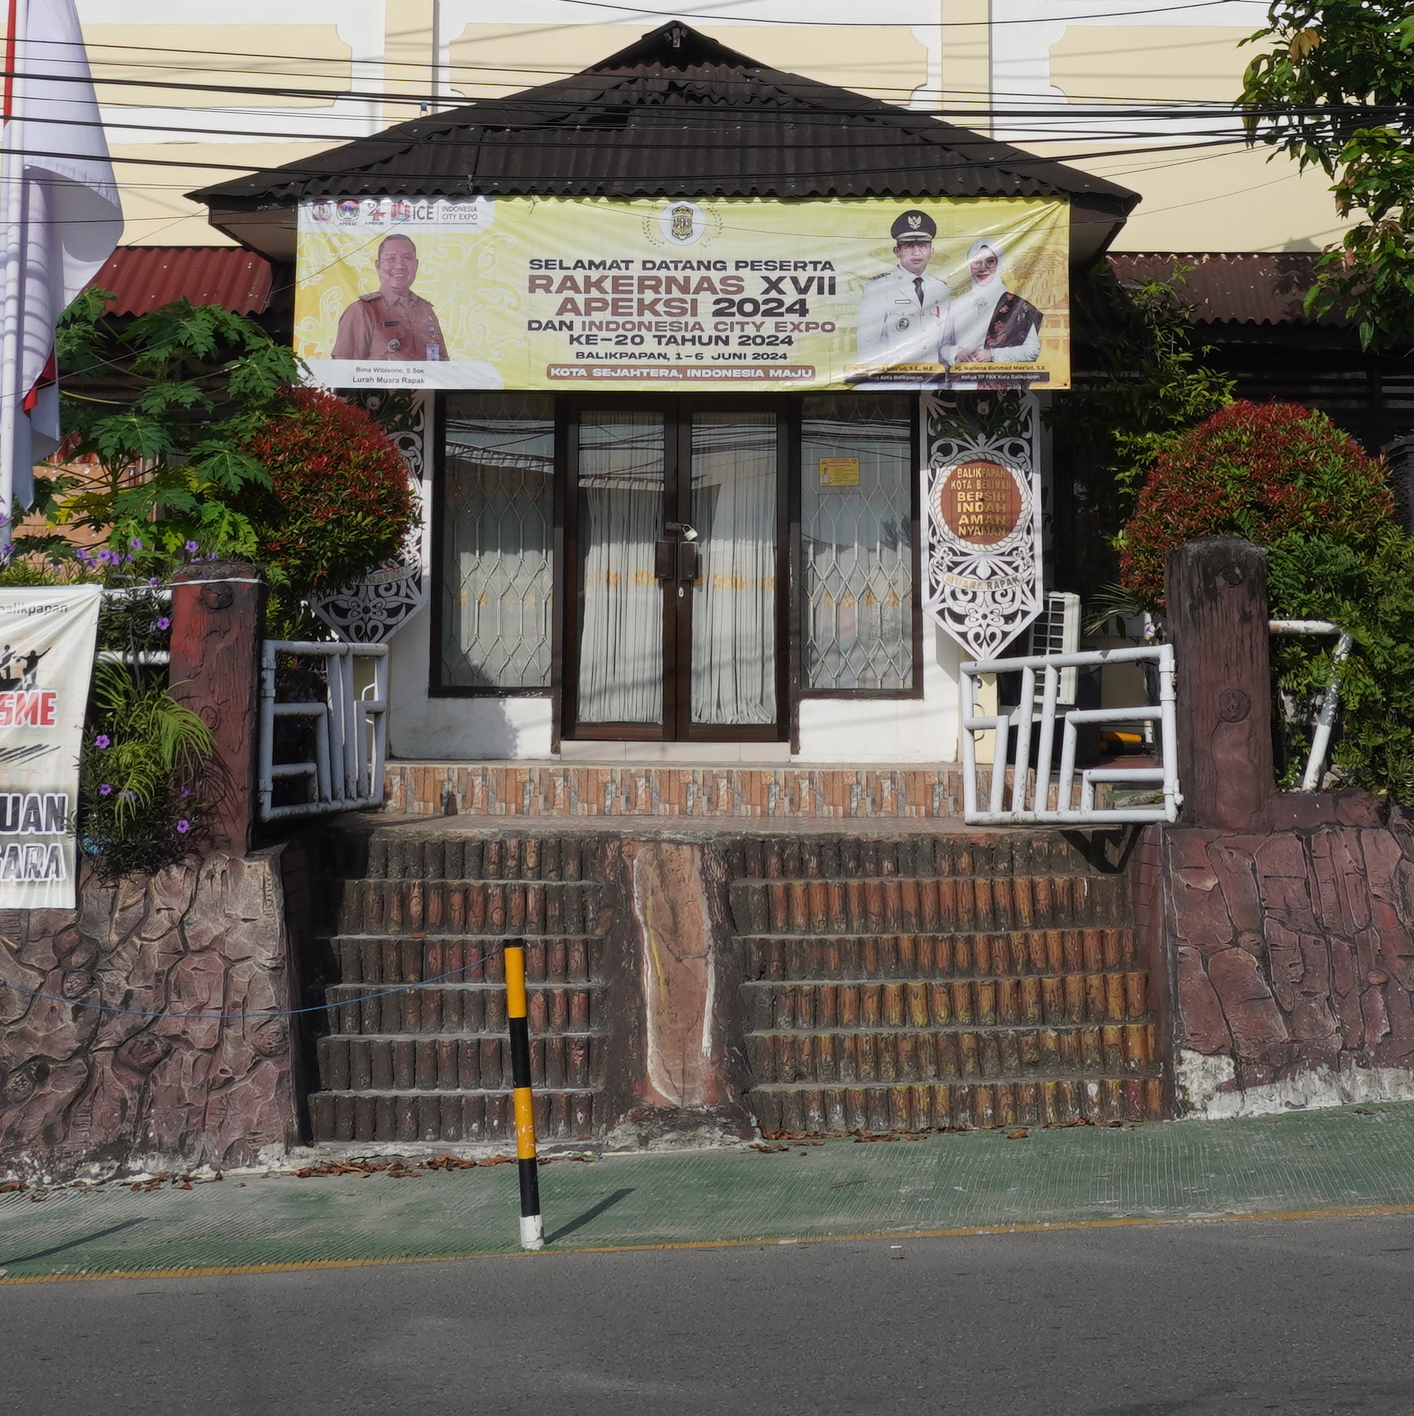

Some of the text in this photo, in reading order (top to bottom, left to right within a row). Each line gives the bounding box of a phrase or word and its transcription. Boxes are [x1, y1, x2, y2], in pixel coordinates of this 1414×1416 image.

[412, 205, 434, 221] ICE
[441, 205, 478, 213] INDONESIA
[529, 259, 835, 272] SELAMAT DATANG PESERTA
[528, 274, 836, 295] RAKERNAS XVII
[554, 297, 809, 318] APEKSI 2024
[527, 320, 836, 333] DAN INDONESIA CITY EXPO
[569, 334, 794, 347] KE-20 TAHUN 2024
[575, 351, 671, 362] BALIKPAPAN,
[711, 352, 747, 361] JUNI
[751, 352, 788, 361] 2024
[550, 367, 812, 379] KOTA SEJAHTERA, INDONESIA MAJU
[352, 376, 425, 385] Lurah Muara Rapak
[957, 467, 1006, 478] BALIKPAPAN
[950, 479, 1012, 490] KOTA BERIMAN
[957, 491, 1006, 502] BERSIH
[957, 502, 1006, 513] INDAH
[958, 514, 1006, 525] AMAN
[958, 525, 1006, 537] NYAMAN
[946, 573, 1021, 590] MUARA RAPAK
